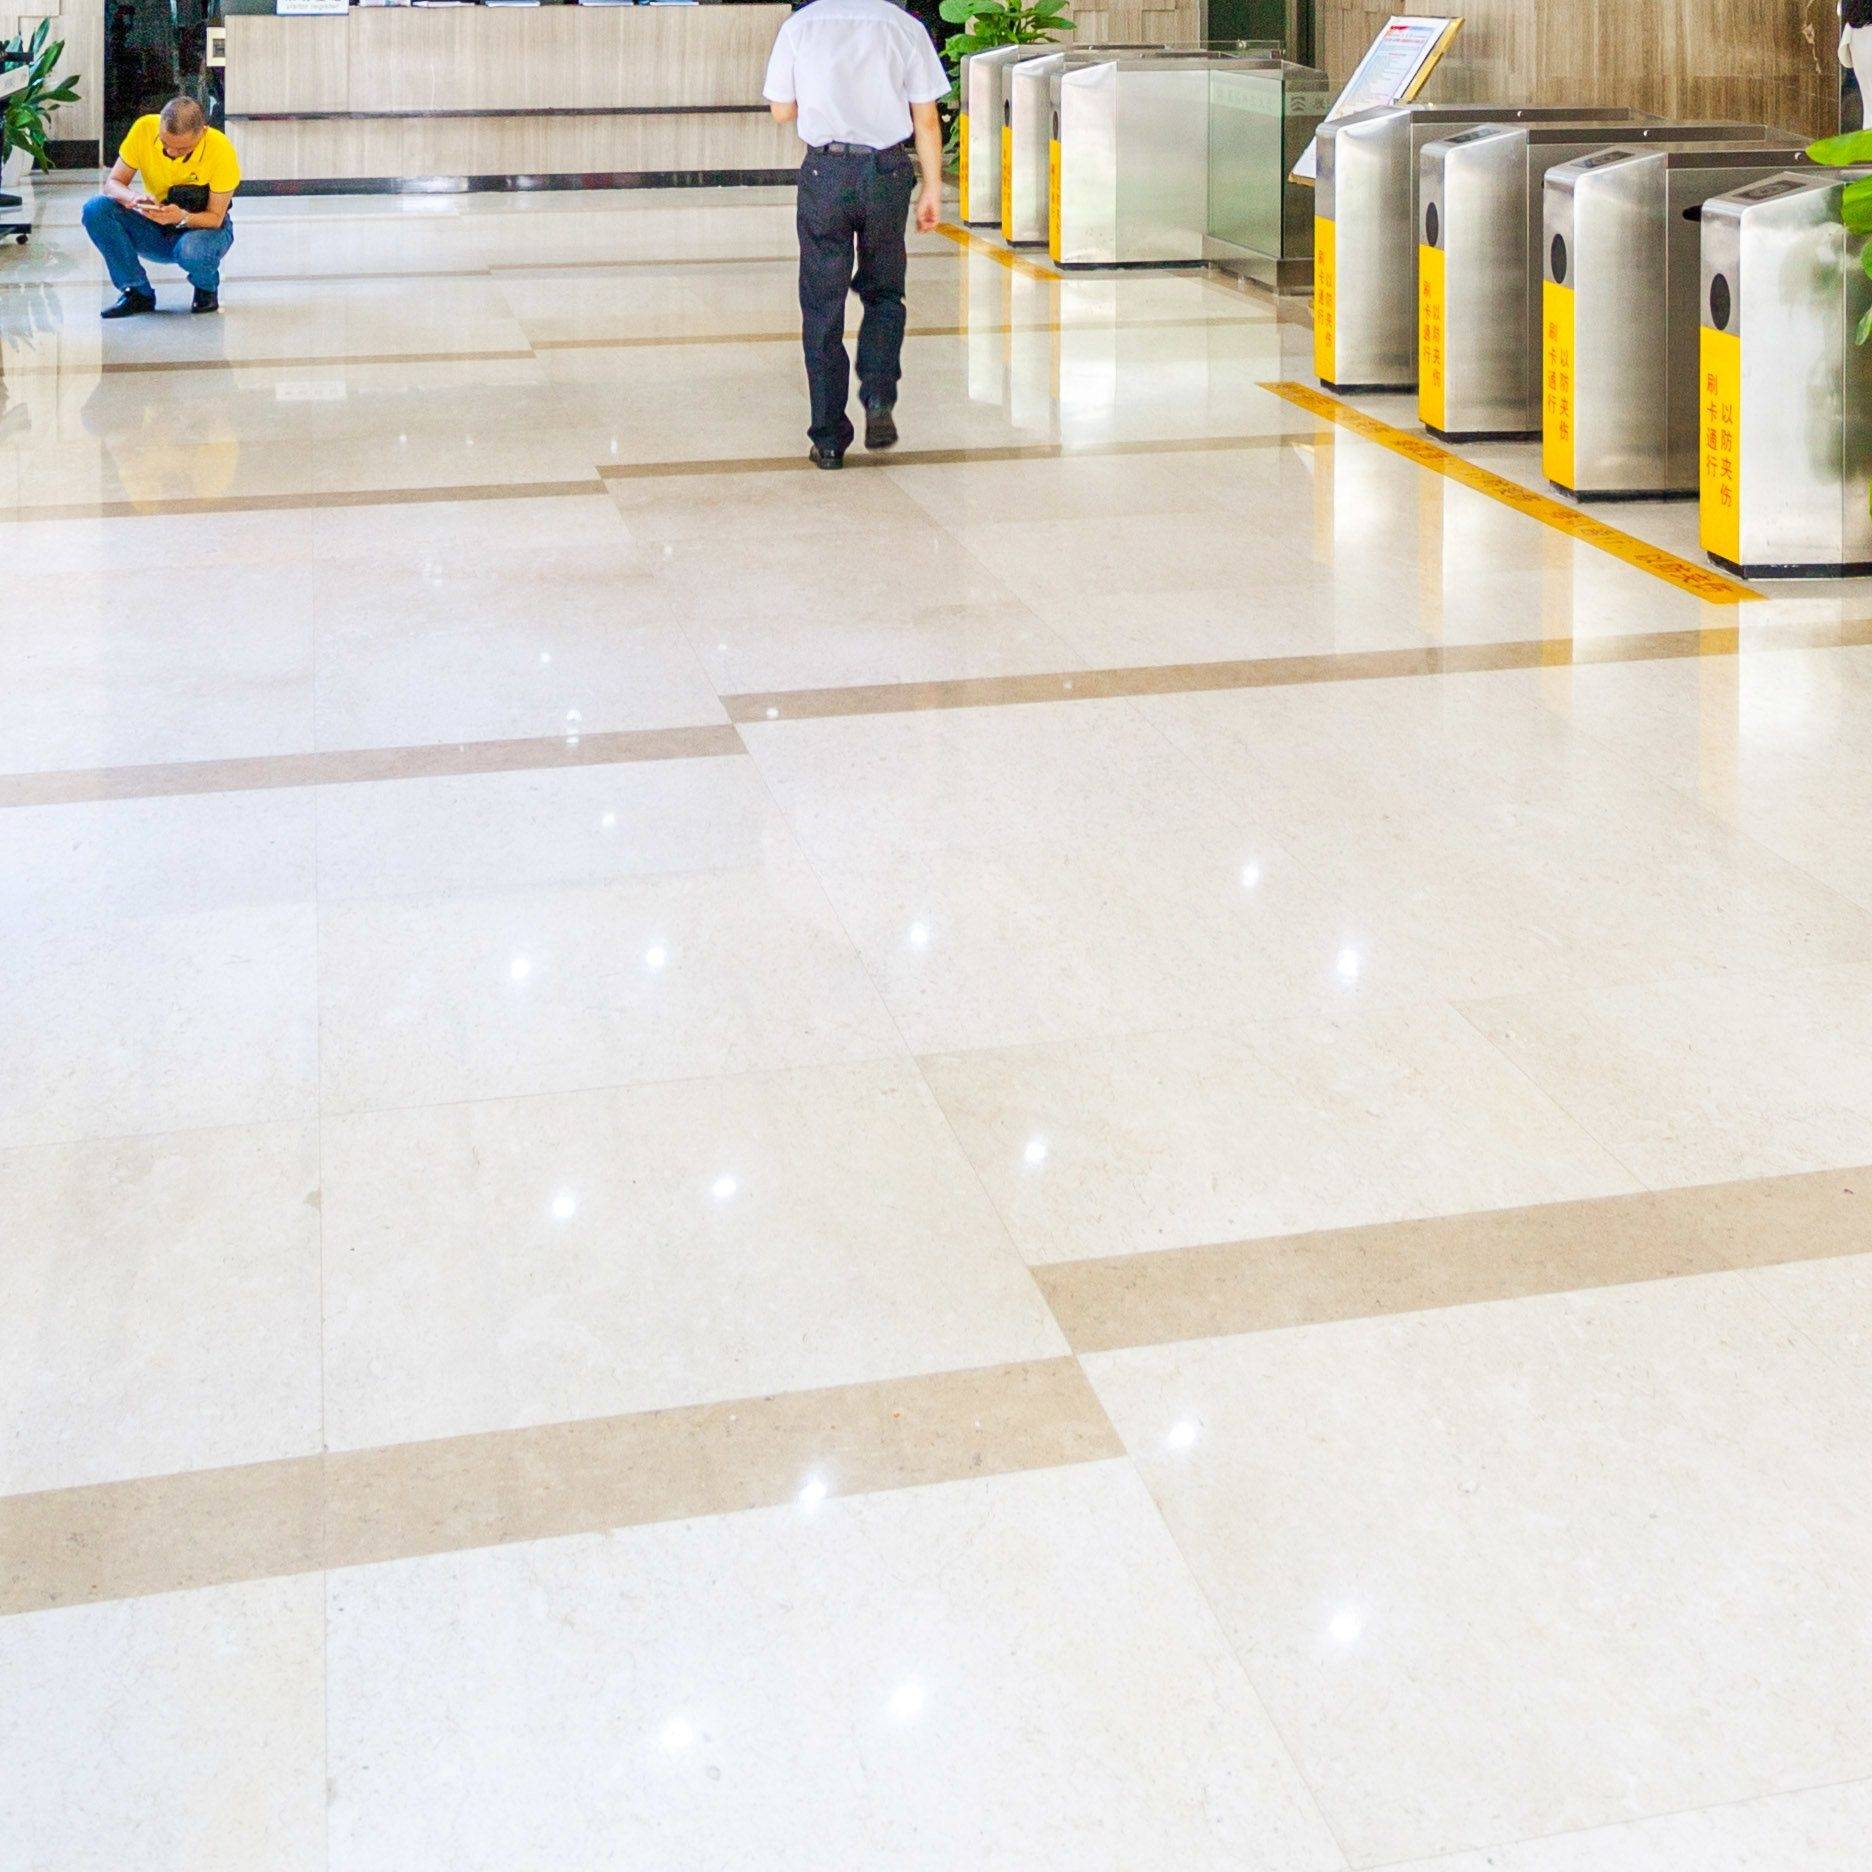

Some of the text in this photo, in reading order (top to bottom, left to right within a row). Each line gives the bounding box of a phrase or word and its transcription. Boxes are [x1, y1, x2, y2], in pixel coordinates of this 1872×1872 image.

[1706, 373, 1718, 478] 刷卡通行
[1720, 402, 1734, 508] 以防夹伤
